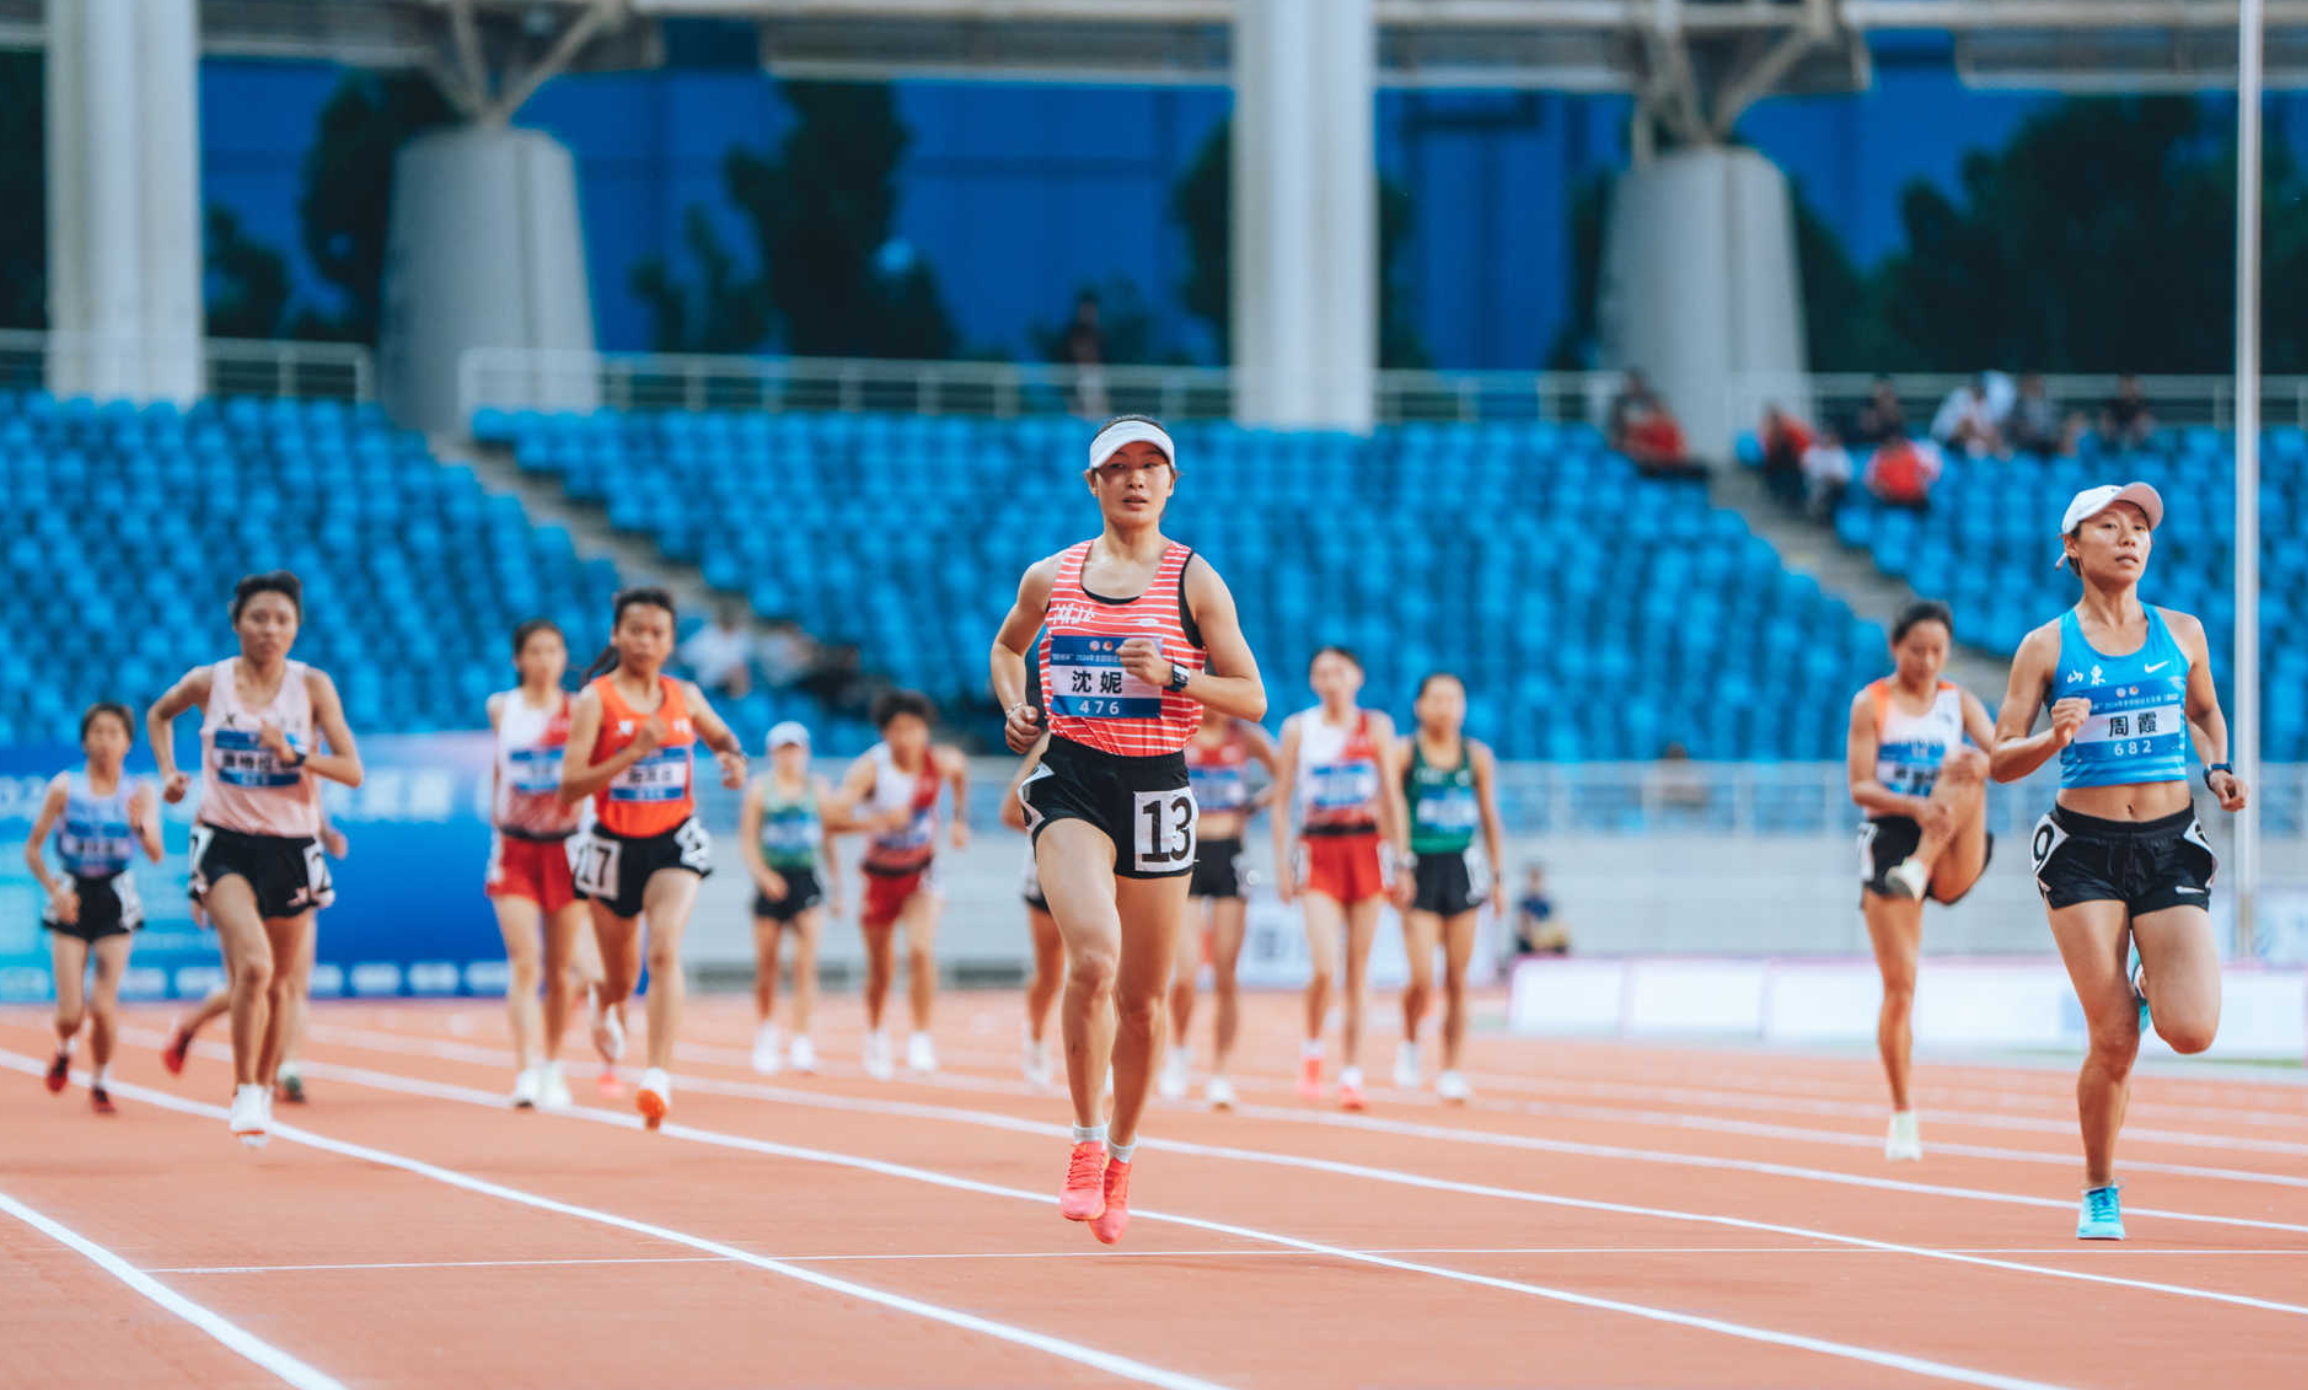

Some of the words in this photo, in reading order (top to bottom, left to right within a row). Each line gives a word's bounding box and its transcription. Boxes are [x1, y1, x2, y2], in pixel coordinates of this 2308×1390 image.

[1072, 670, 1122, 694] 沈妮
[1079, 700, 1119, 715] 476
[2108, 711, 2157, 737] 周霞
[2114, 739, 2152, 756] 682
[1141, 796, 1192, 863] 13
